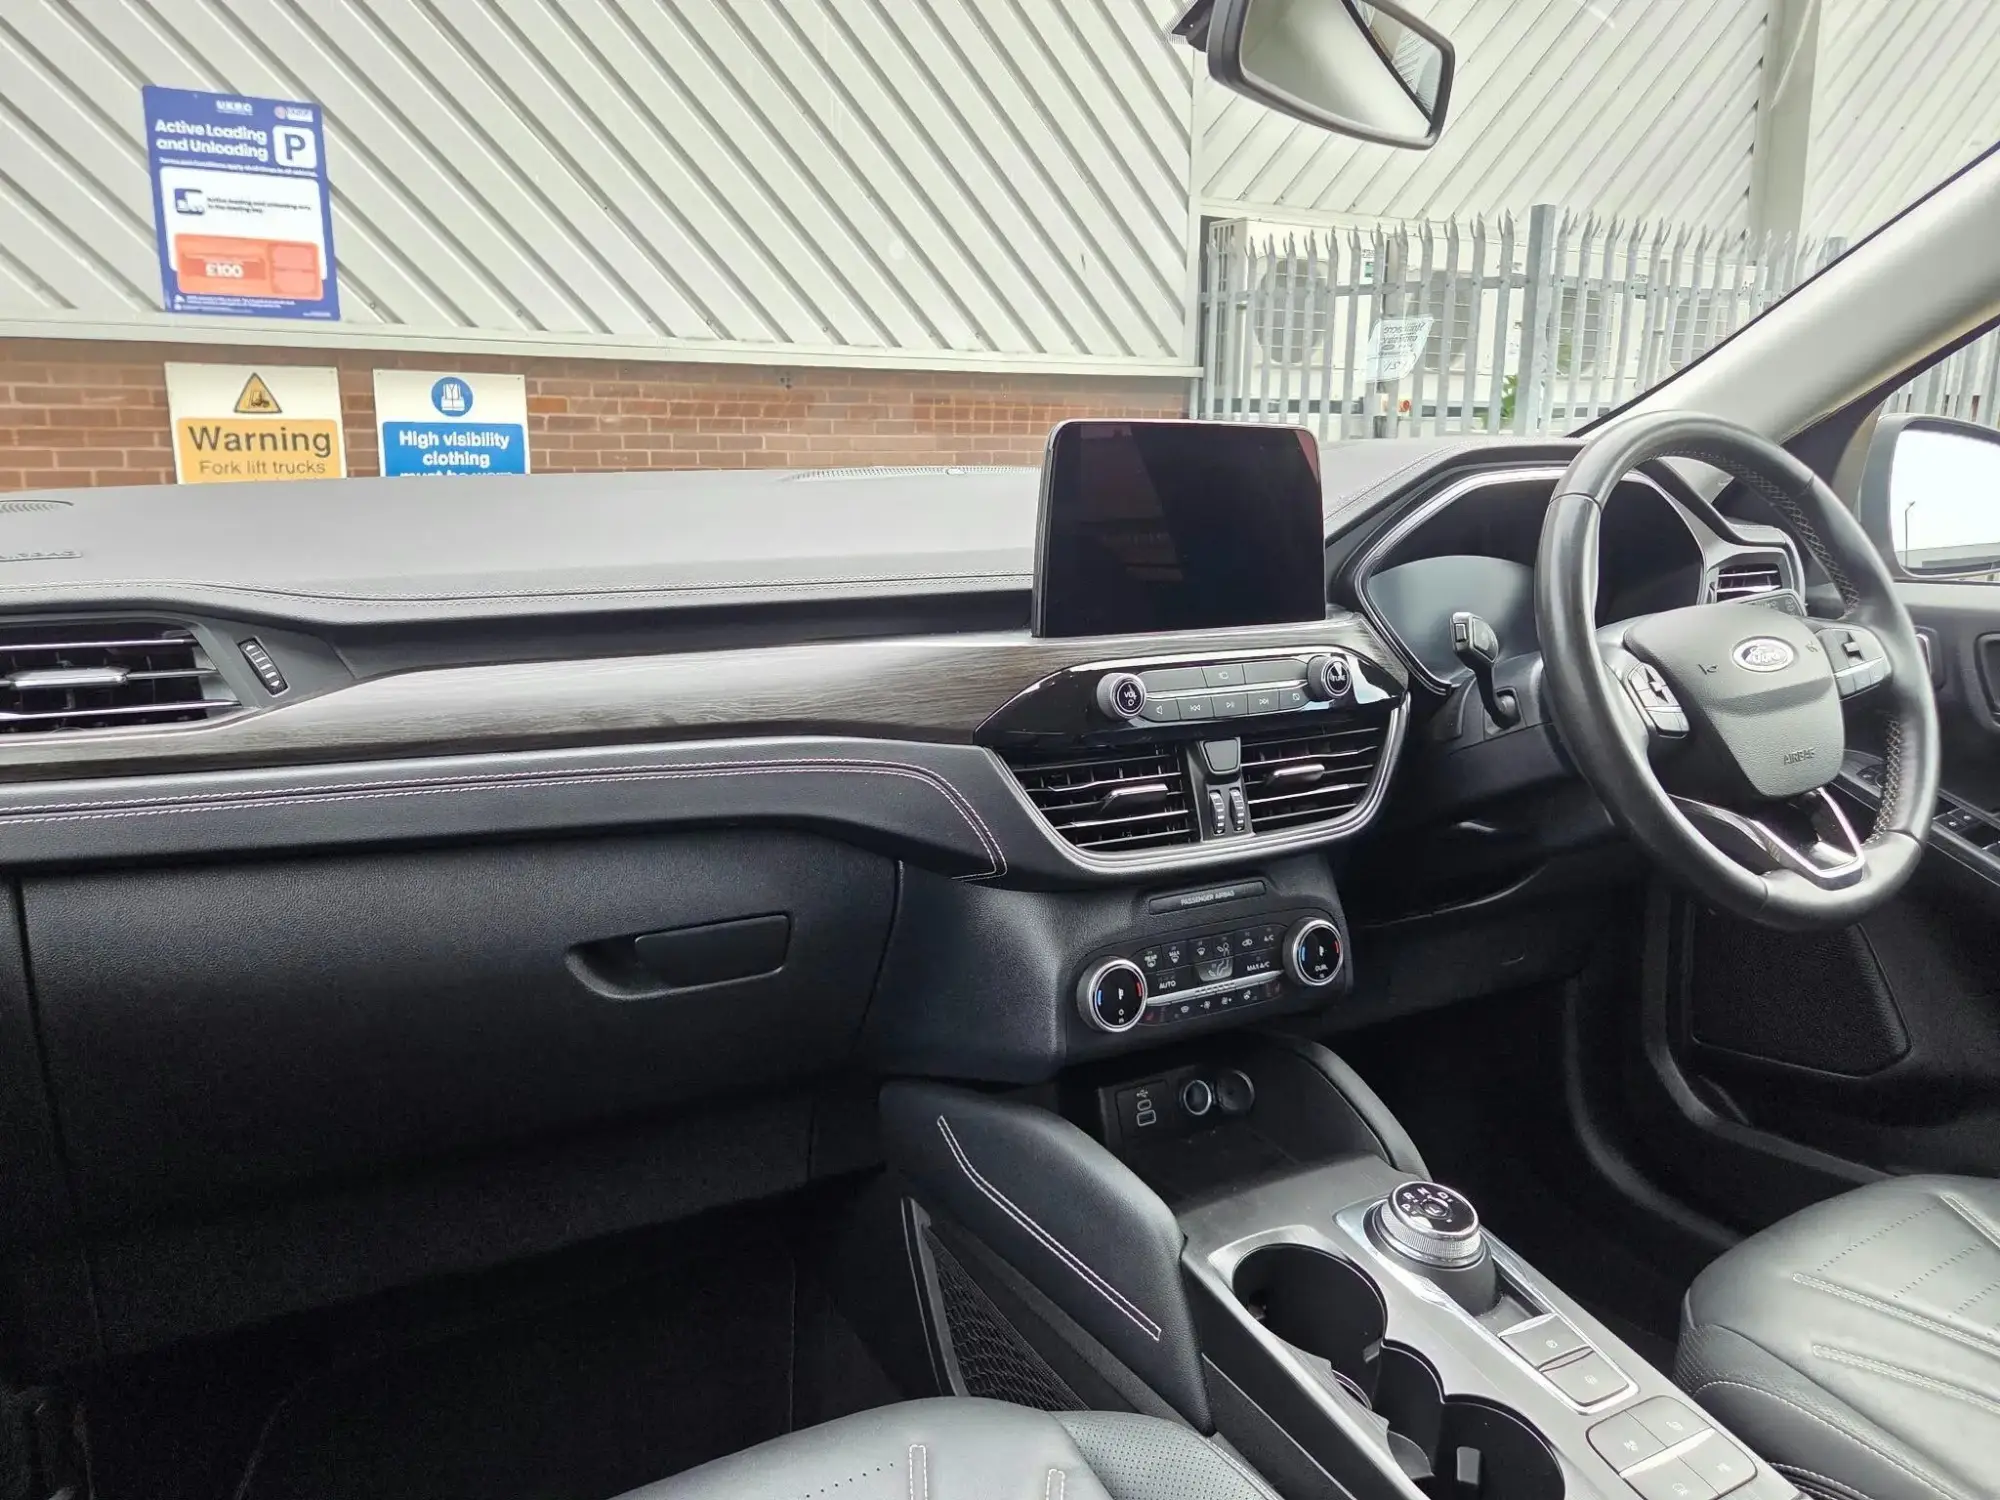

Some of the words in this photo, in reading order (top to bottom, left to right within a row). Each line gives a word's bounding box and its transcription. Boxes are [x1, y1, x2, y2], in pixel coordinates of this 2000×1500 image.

[155, 119, 204, 136] Active
[206, 123, 268, 145] Loading
[156, 138, 188, 151] and
[191, 139, 269, 162] Unloading
[284, 133, 306, 161] P
[206, 262, 244, 278] £100
[188, 425, 331, 458] Warning
[399, 430, 439, 449] High
[443, 431, 510, 449] visibility
[422, 451, 490, 468] clothing
[199, 460, 241, 475] Fork
[247, 460, 267, 474] lift
[273, 460, 326, 474] trucks
[1123, 690, 1137, 700] VOL
[1159, 980, 1177, 990] AUTO
[1403, 1192, 1414, 1200] R
[1417, 1187, 1430, 1195] N
[1437, 1192, 1448, 1200] D
[1401, 1203, 1411, 1212] P
